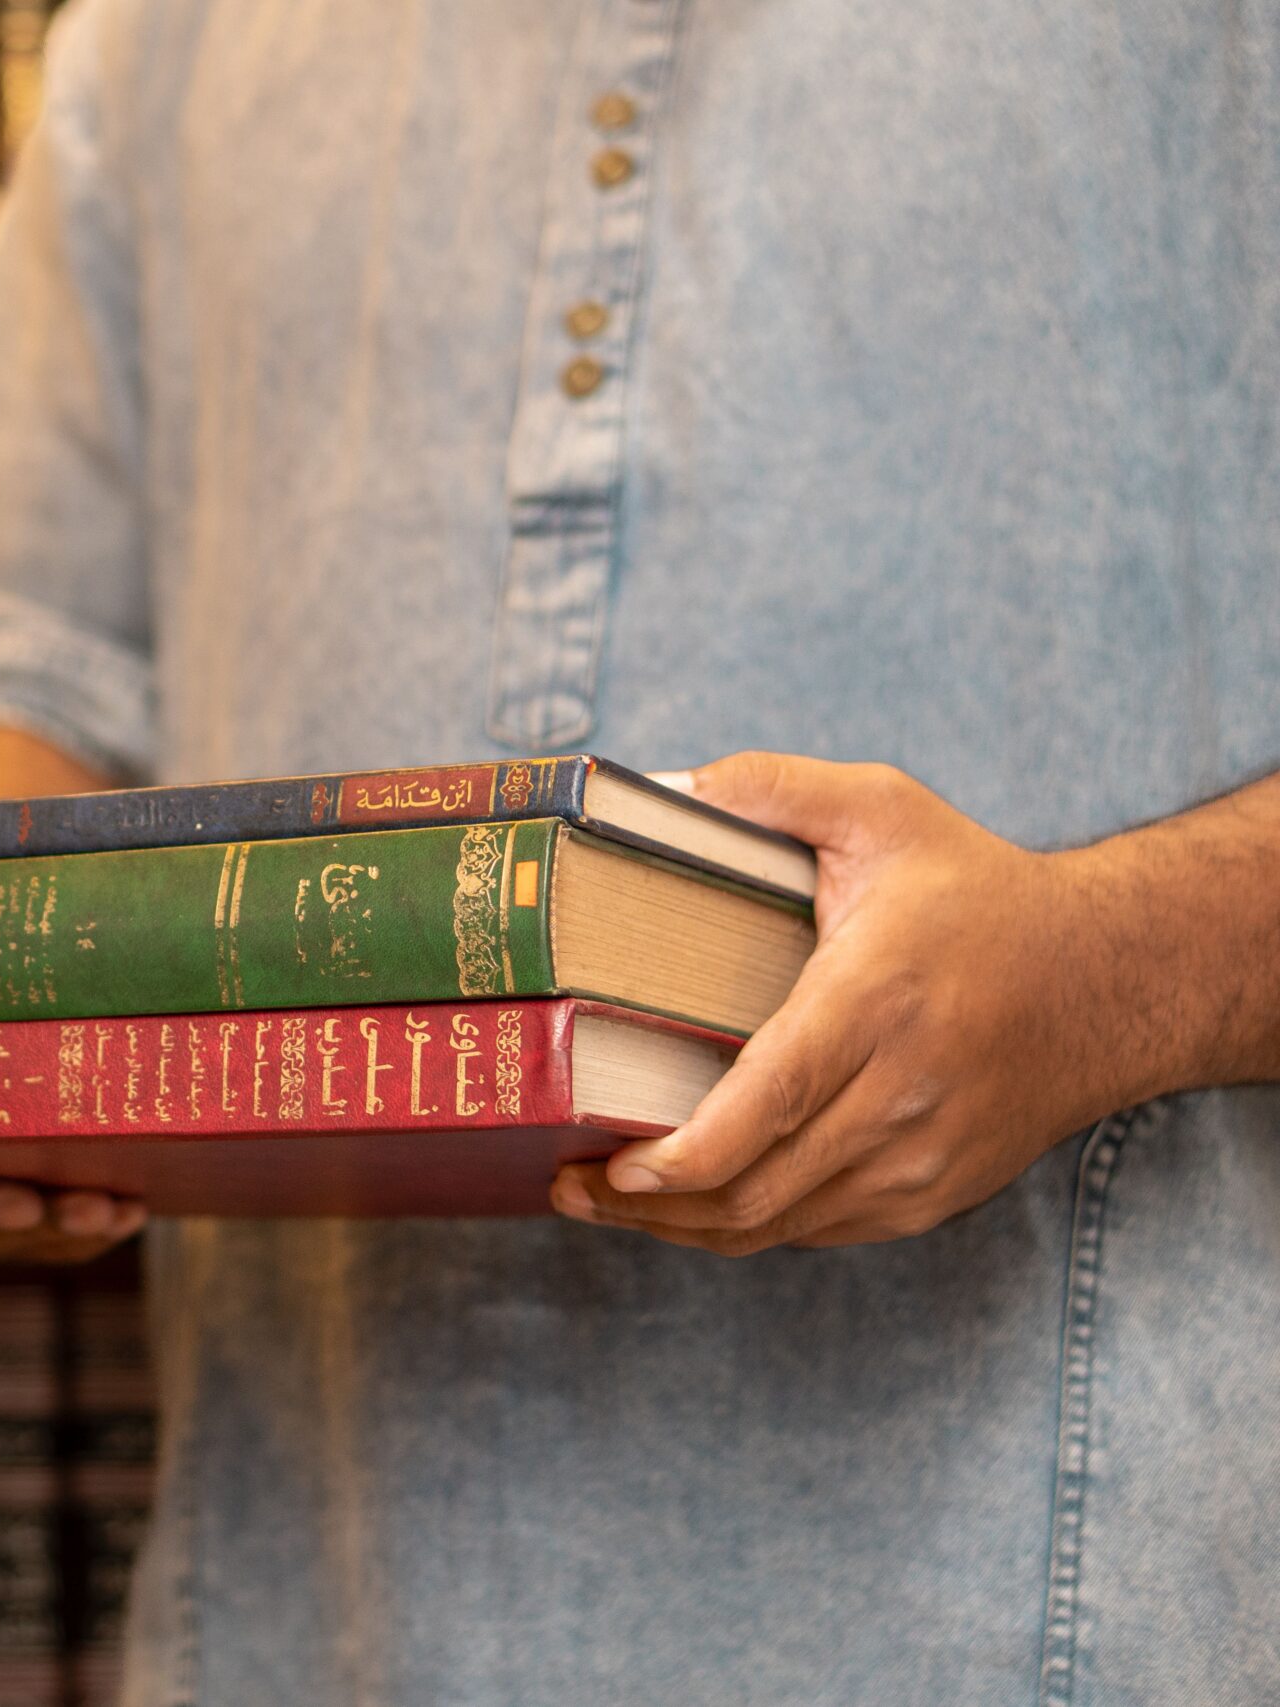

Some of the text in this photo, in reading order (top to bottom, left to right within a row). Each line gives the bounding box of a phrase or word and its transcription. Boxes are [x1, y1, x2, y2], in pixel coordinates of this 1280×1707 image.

[314, 1018, 348, 1116] الدرب
[359, 1016, 394, 1116] على
[404, 1011, 439, 1116] نور
[449, 1013, 486, 1117] فتاوى
